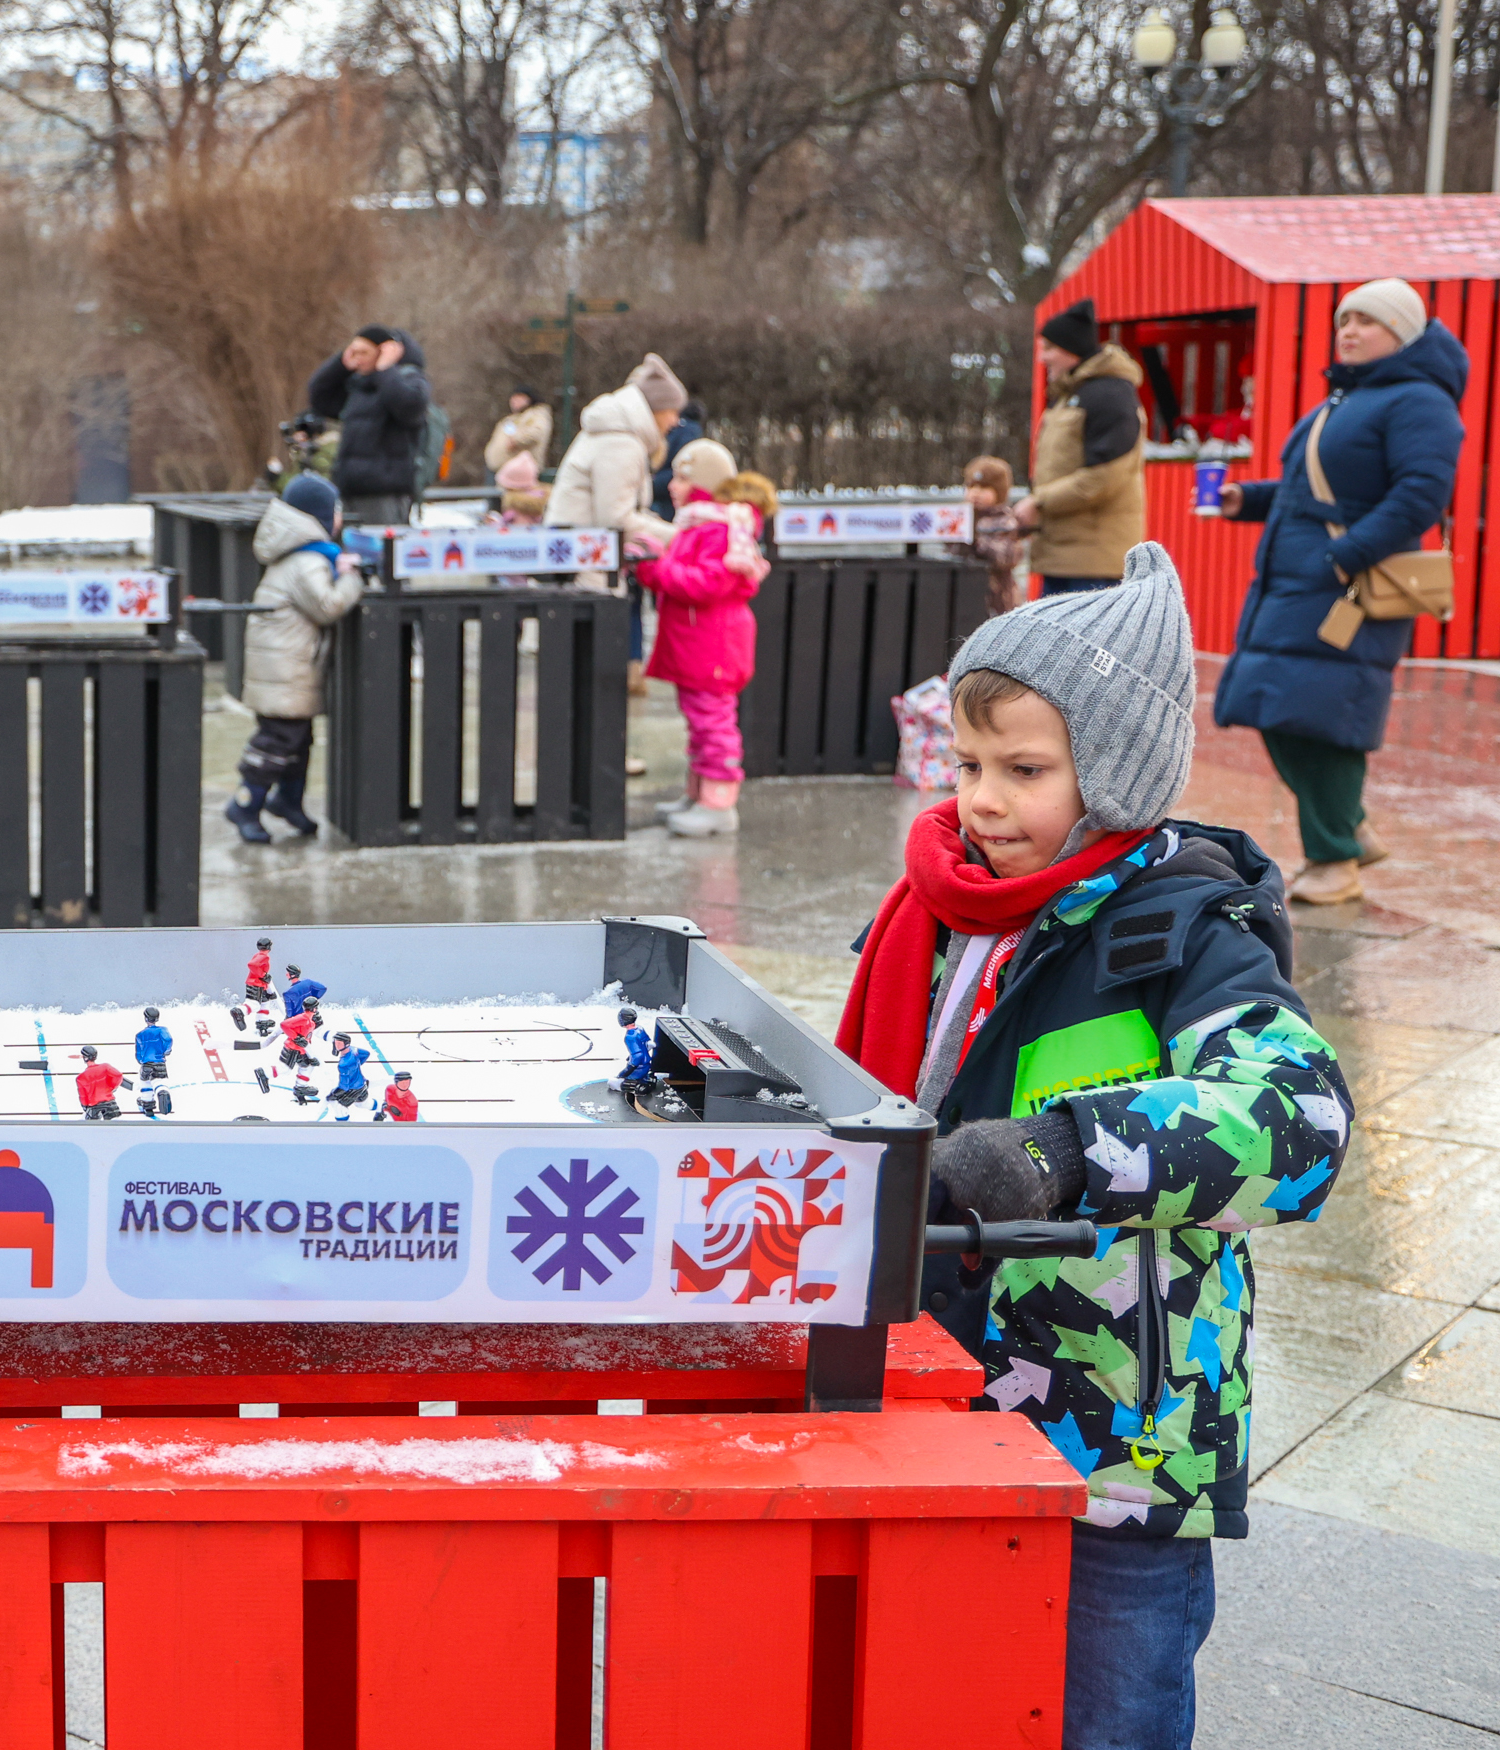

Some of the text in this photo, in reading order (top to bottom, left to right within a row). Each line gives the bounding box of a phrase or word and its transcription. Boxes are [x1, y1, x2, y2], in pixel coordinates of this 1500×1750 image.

[124, 1181, 222, 1196] ФЕСТИВАЛЬ
[118, 1199, 460, 1235] МОСКОВСКИЕ
[299, 1239, 458, 1262] ТРАДИЦИИ
